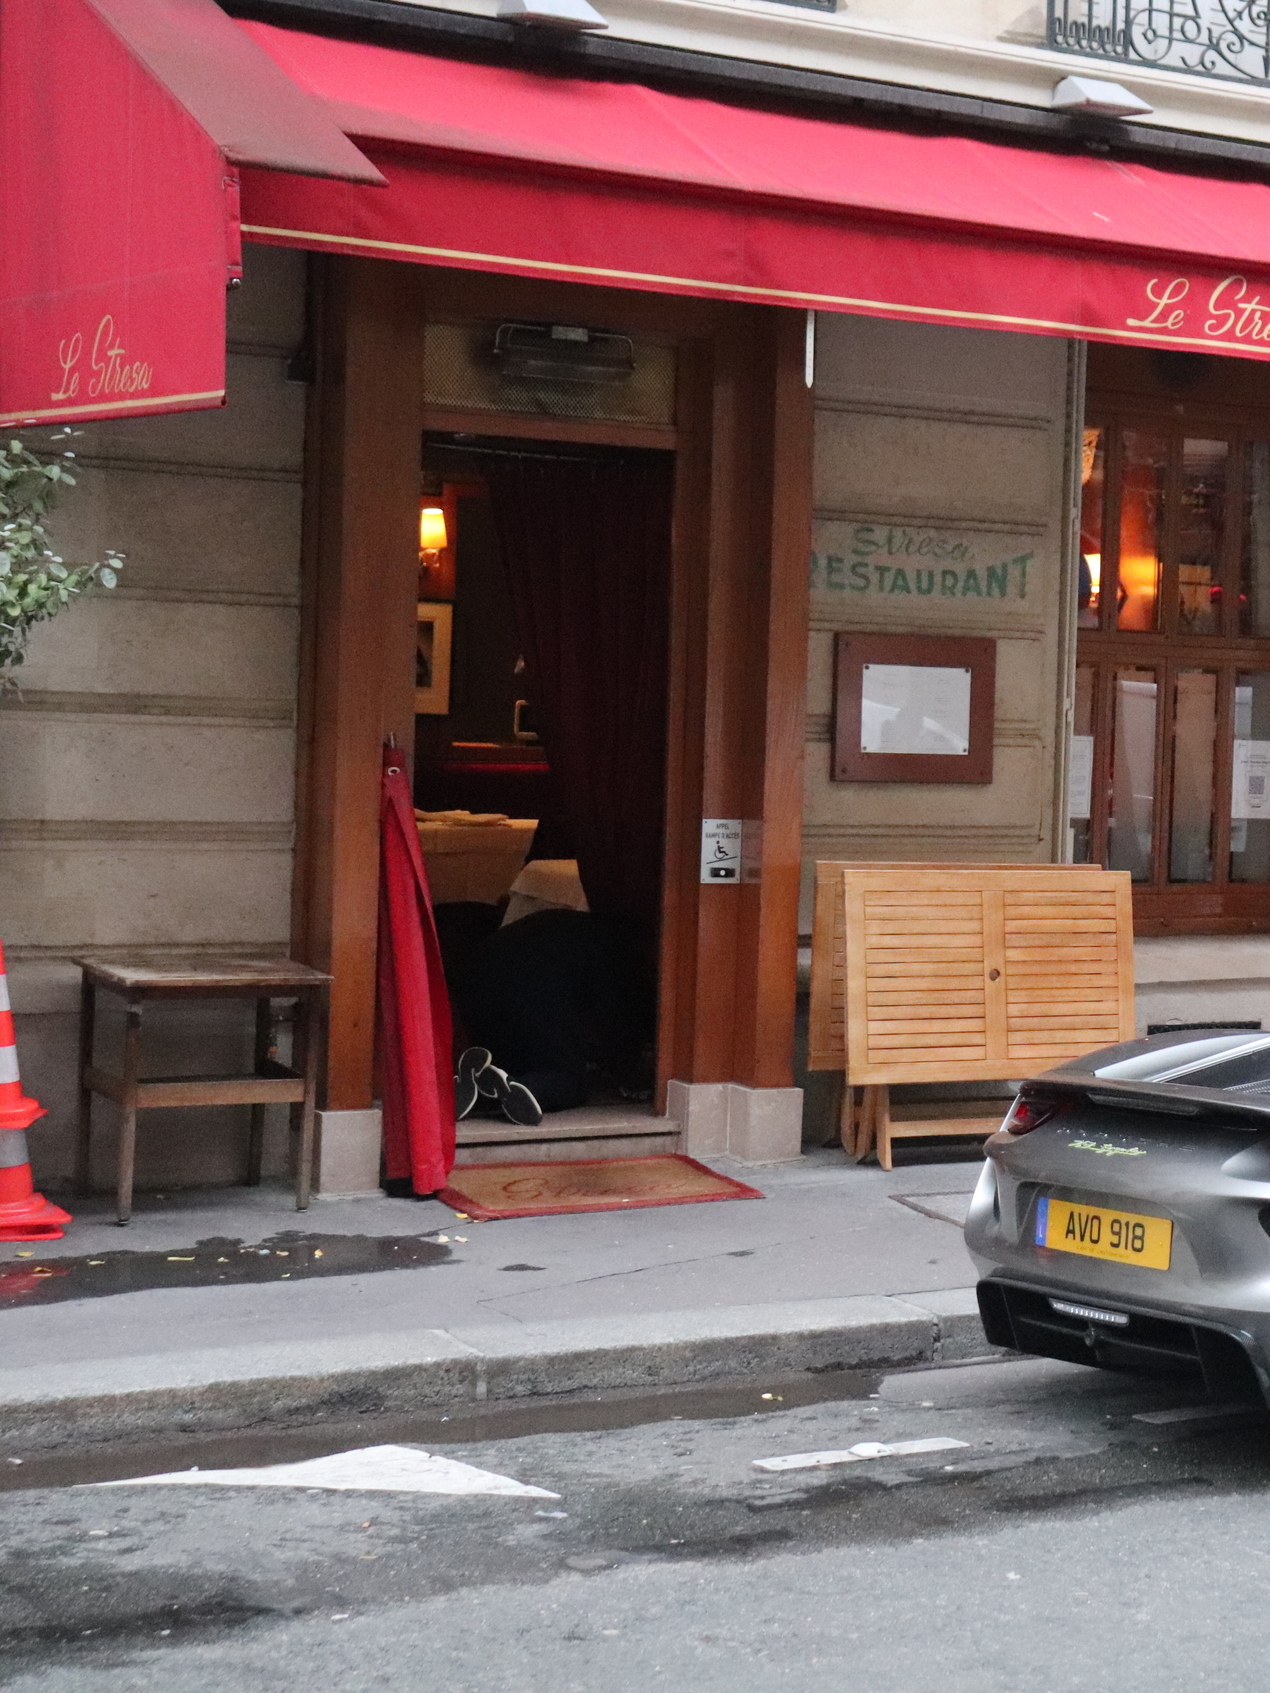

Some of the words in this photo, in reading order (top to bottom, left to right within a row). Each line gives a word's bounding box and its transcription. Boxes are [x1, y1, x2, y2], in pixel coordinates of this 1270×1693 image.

[1126, 278, 1190, 329] Le
[51, 332, 82, 400] Le
[88, 314, 153, 397] Stresa
[852, 526, 975, 561] Stresa
[1065, 1211, 1101, 1245] AVO
[1110, 1218, 1146, 1253] 918
